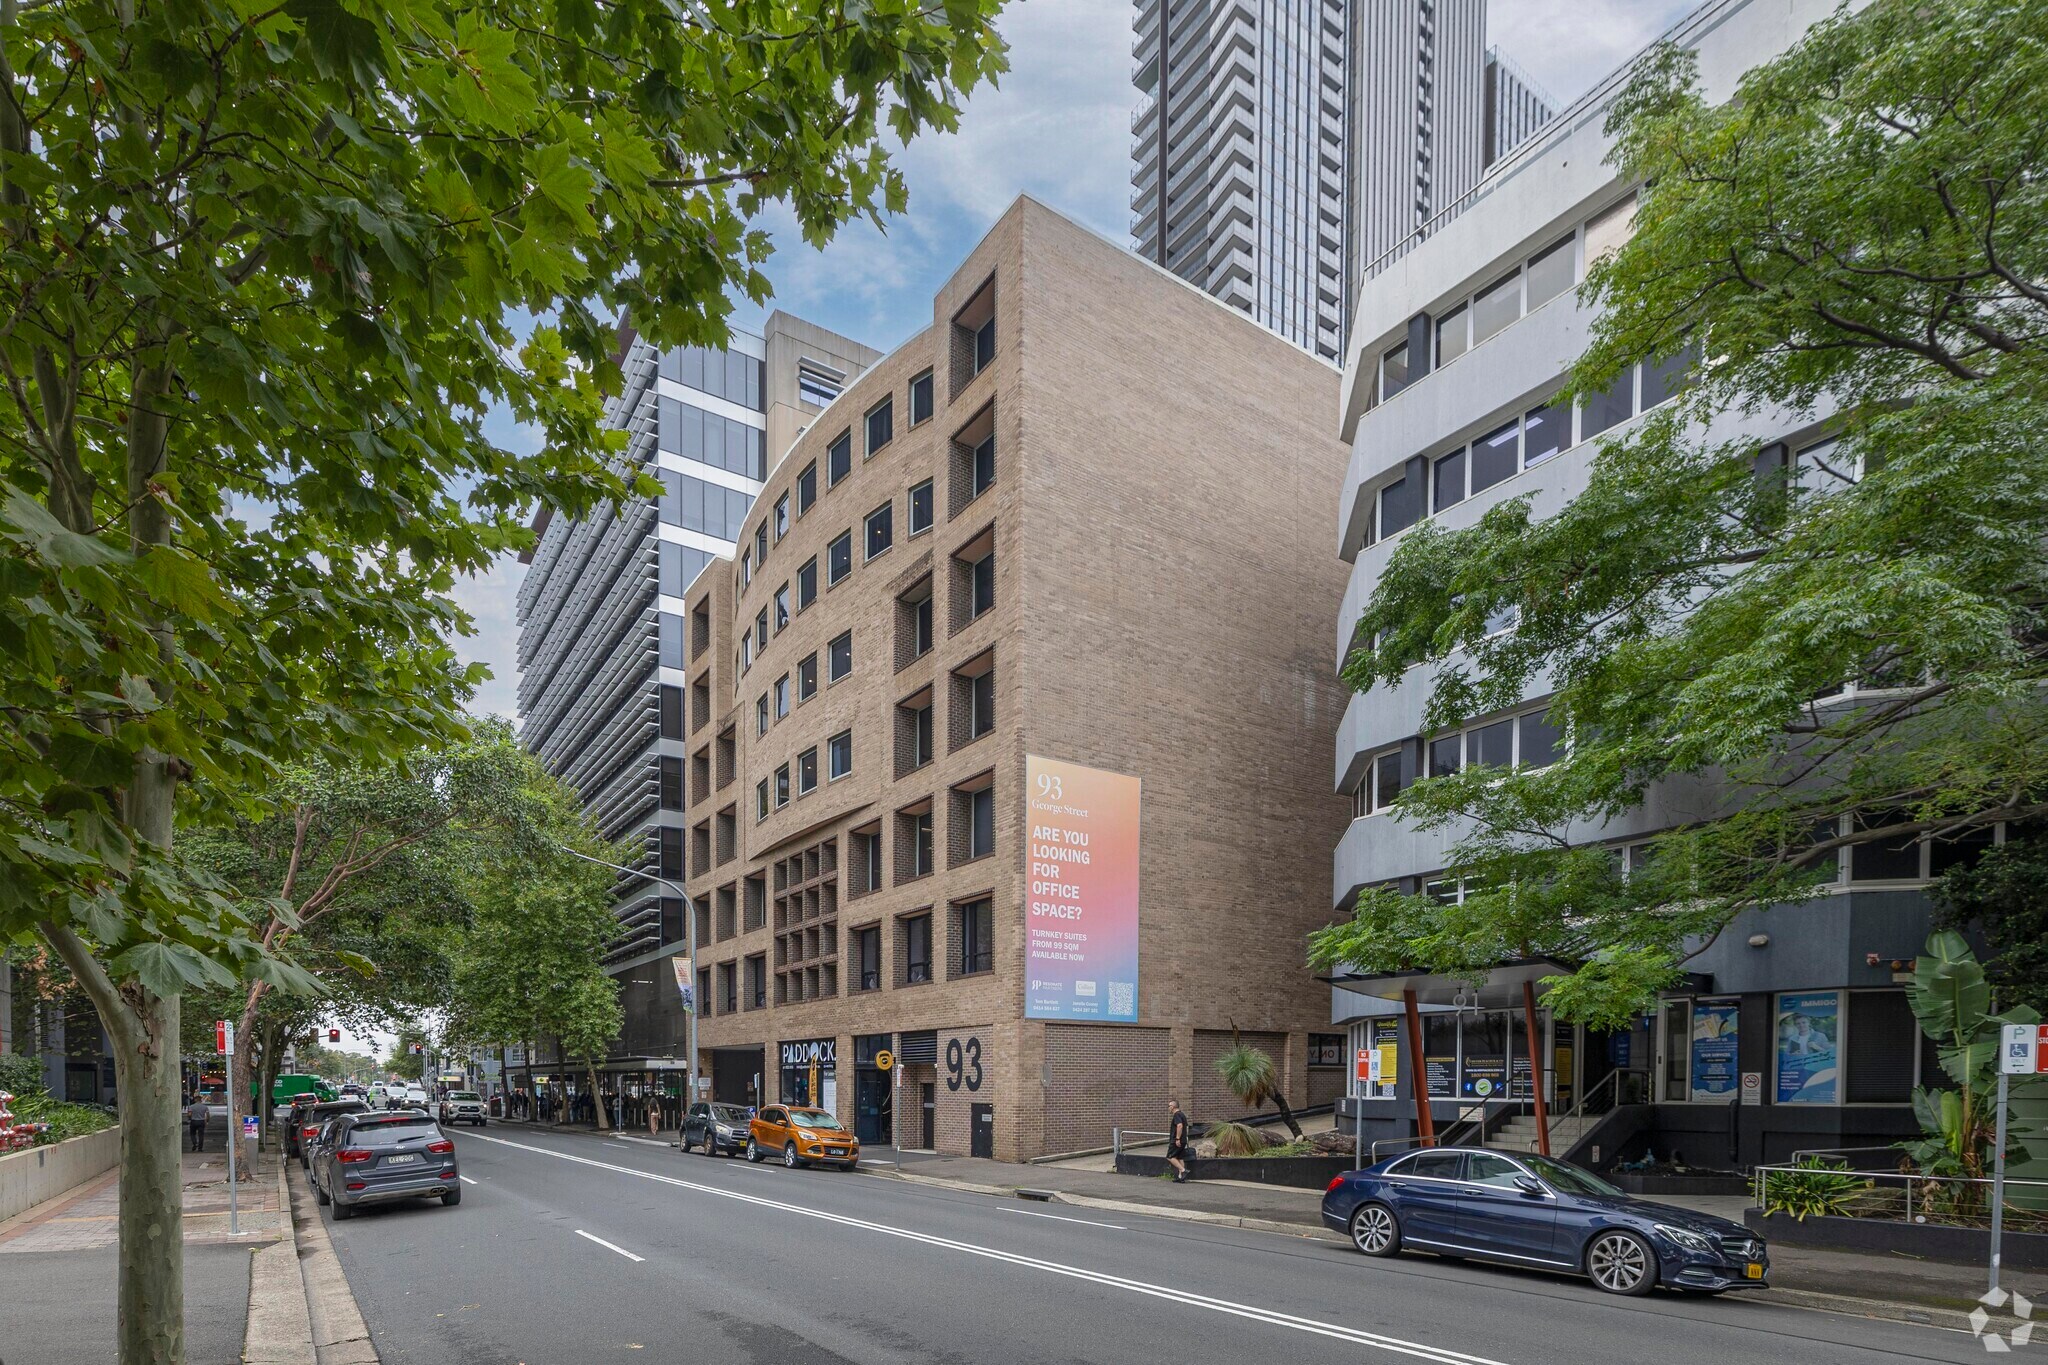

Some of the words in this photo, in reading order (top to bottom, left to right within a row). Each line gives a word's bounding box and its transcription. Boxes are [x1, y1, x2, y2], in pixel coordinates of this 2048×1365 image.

[1037, 773, 1063, 801] 93
[1031, 799, 1063, 815] George
[1063, 804, 1089, 818] Street
[1033, 825, 1060, 842] ARE
[1063, 829, 1089, 847] YOU
[1033, 843, 1090, 865] LOOKING
[1033, 862, 1060, 879] FOR
[1032, 880, 1080, 899] OFFICE
[1032, 901, 1083, 920] SPACE?
[1032, 929, 1063, 939] TURNKEY
[1063, 932, 1088, 942] SUITES
[1032, 940, 1052, 949] FROM
[1053, 942, 1062, 950] 99
[1063, 943, 1080, 952] SQM
[1032, 951, 1068, 961] AVAILABLE
[1068, 953, 1085, 962] NOW
[1453, 993, 1479, 1017] 91
[2013, 1028, 2026, 1039] P
[946, 1036, 983, 1092] 93
